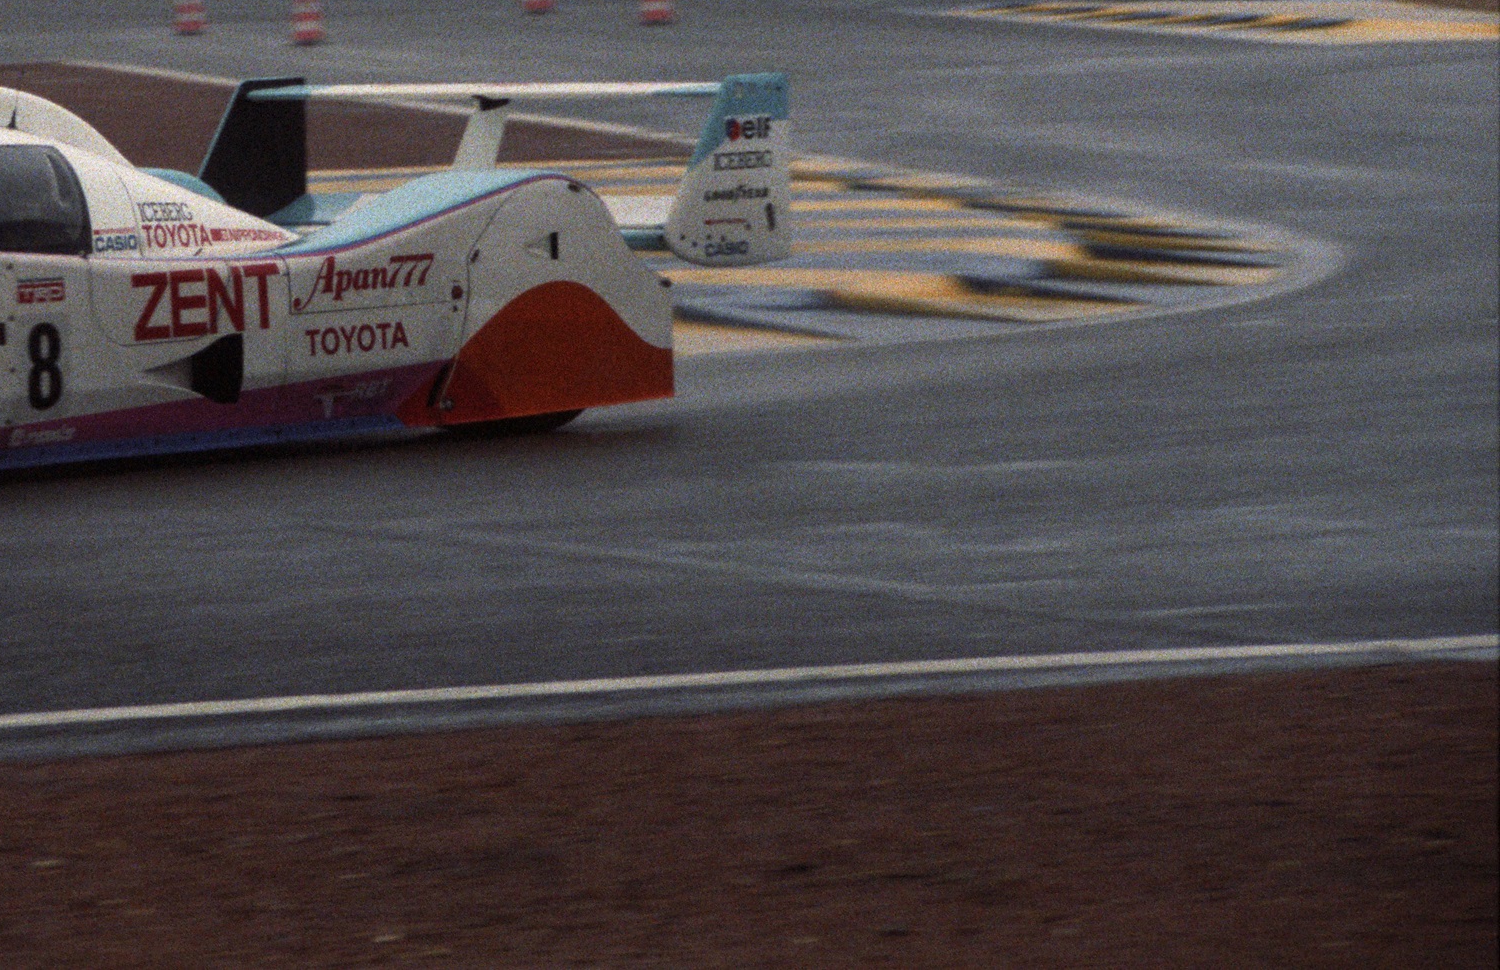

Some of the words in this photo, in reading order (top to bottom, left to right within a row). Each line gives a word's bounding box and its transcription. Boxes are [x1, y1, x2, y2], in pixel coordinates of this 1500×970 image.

[136, 202, 194, 223] ICEBERG
[94, 234, 138, 252] CASIO
[142, 223, 214, 249] TOYOTA
[132, 262, 280, 342] ZENT
[305, 321, 410, 357] TOYOTA
[27, 322, 62, 411] 8
